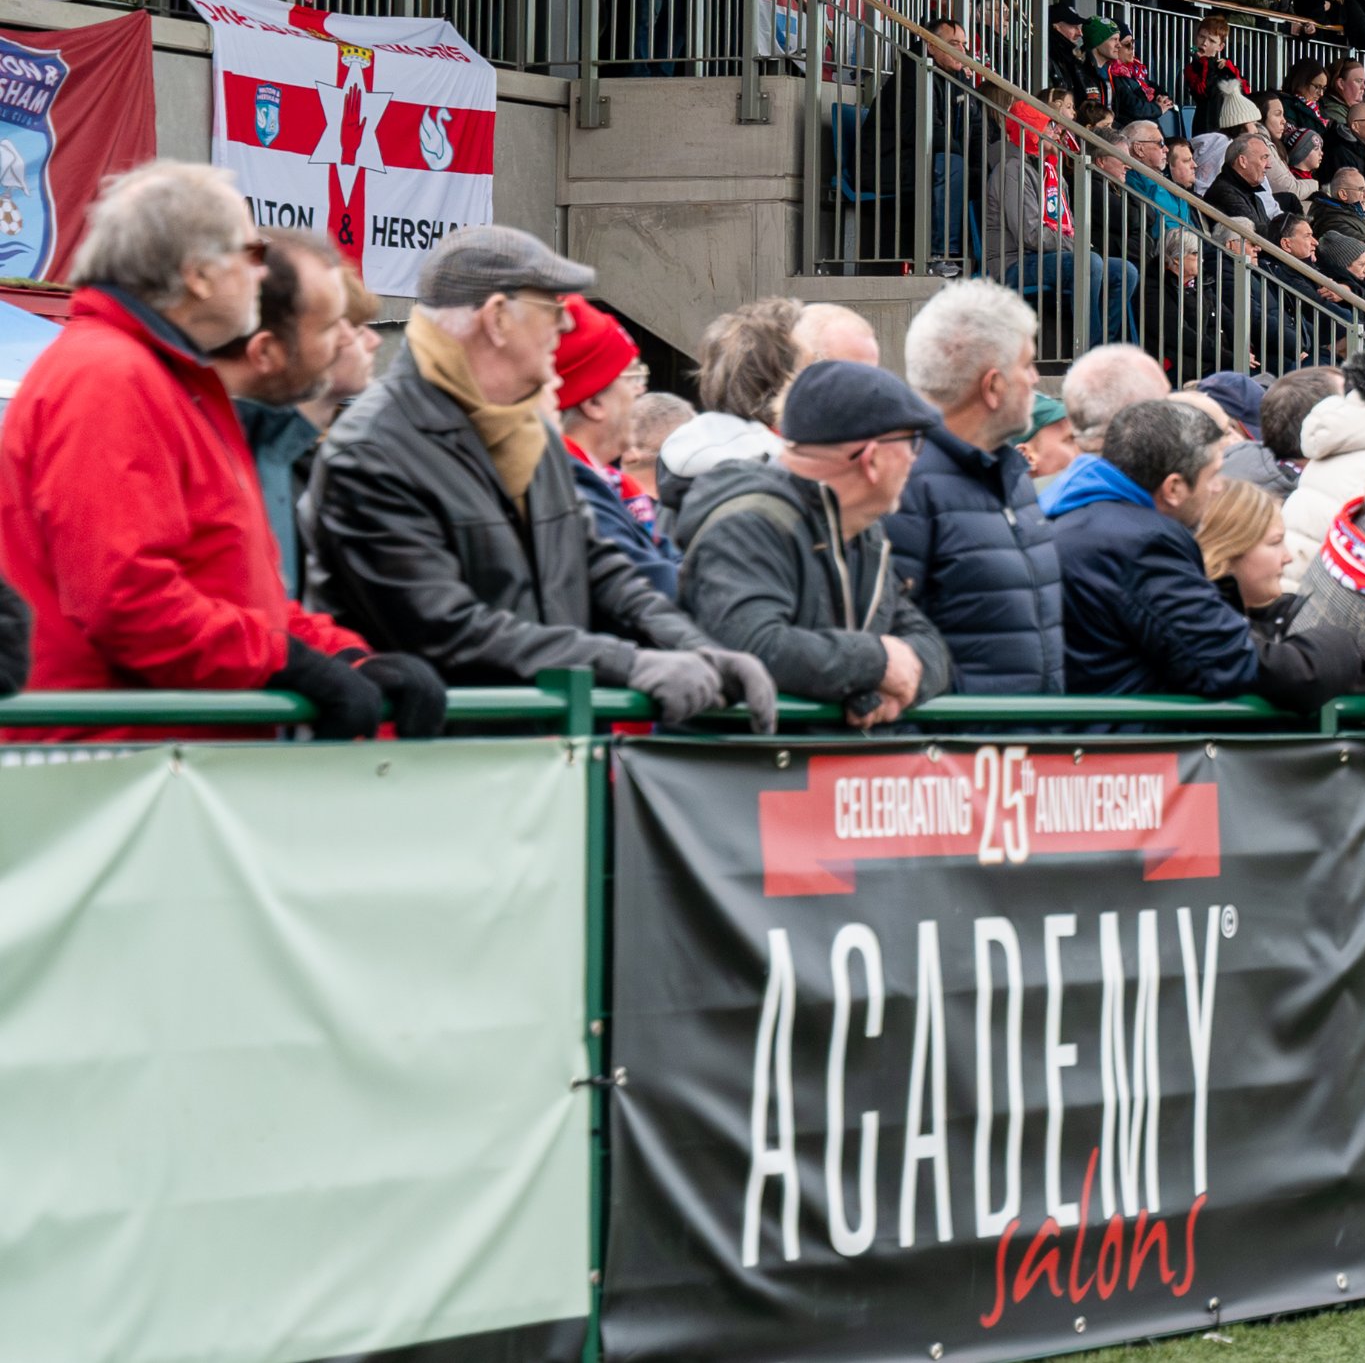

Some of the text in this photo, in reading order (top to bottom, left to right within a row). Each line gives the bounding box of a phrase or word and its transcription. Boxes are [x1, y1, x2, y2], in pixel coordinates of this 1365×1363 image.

[244, 196, 486, 250] ALTON & HERSH
[834, 745, 1164, 865] CELEBRATING 25th ANNIVERSARY
[980, 1146, 1208, 1328] salons
